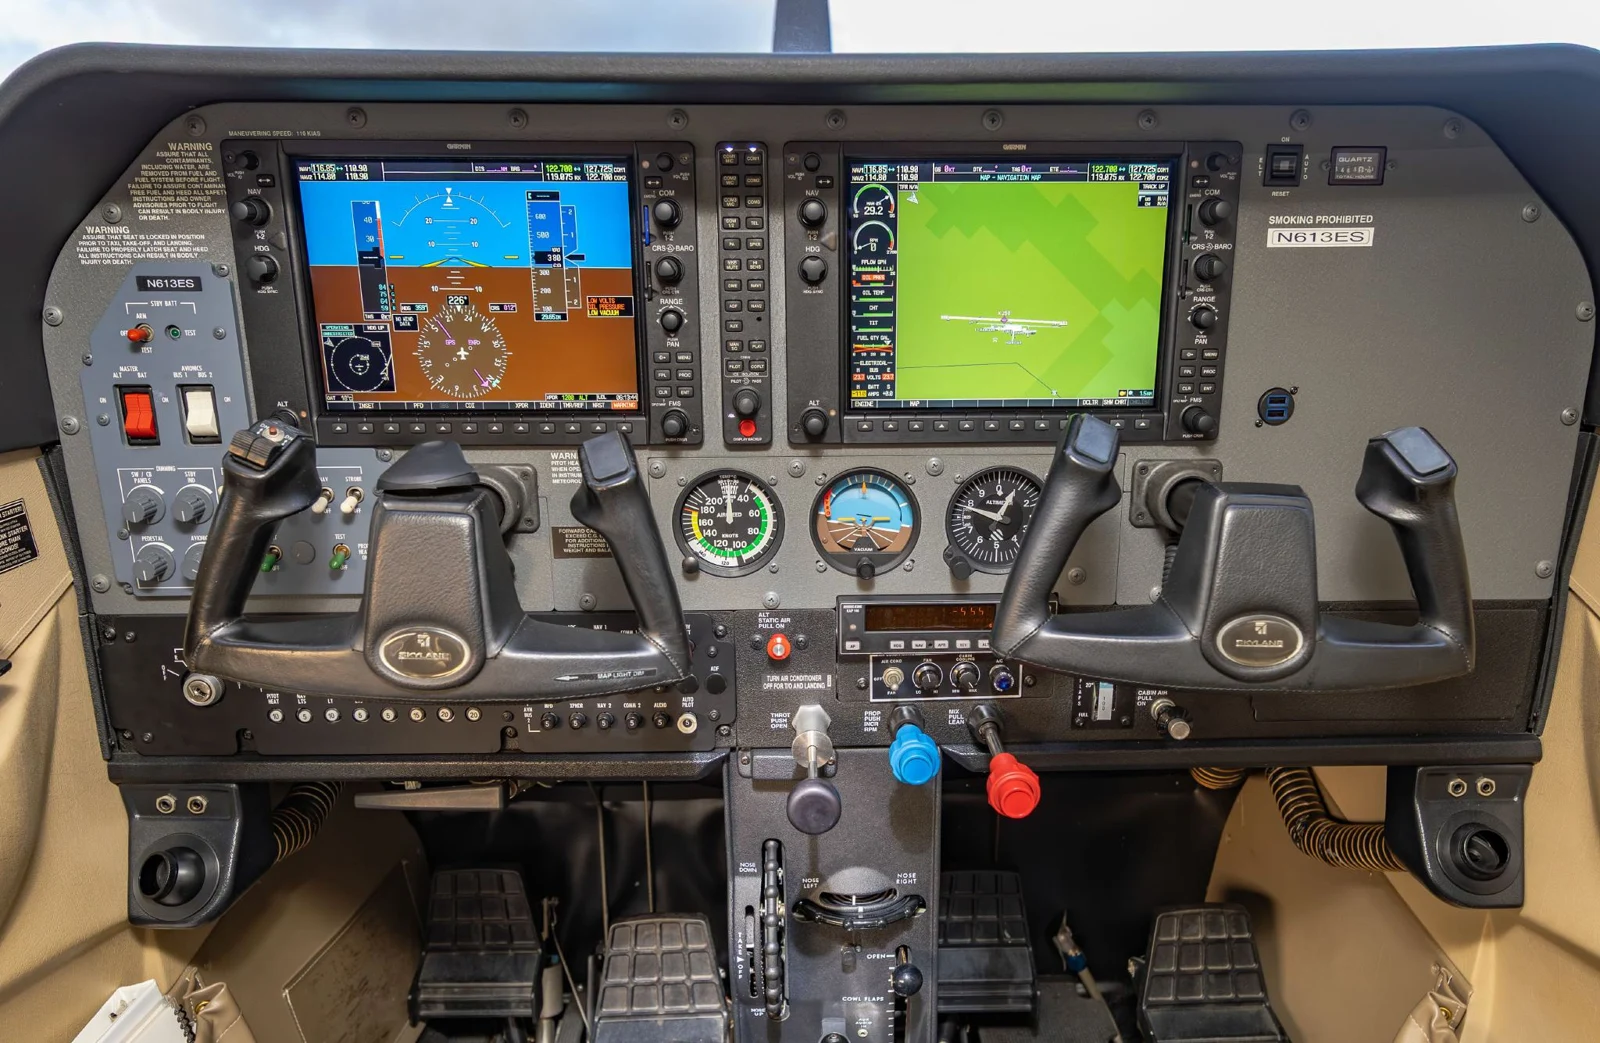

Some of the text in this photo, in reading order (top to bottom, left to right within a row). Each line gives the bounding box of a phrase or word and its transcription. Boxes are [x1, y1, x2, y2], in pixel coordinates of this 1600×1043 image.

[344, 164, 368, 172] 110.90
[864, 206, 883, 215] 29.2
[1269, 215, 1373, 224] SMOKING PROHIBITED
[86, 226, 129, 234] WARNING
[1277, 232, 1364, 242] N613ES
[147, 279, 194, 288] N613ES
[706, 497, 723, 505] 200
[701, 506, 715, 514] 180
[8, 525, 28, 537] STARTER
[703, 529, 717, 537] 140
[733, 540, 747, 548] 100
[763, 682, 773, 690] OFF
[774, 682, 783, 690] FOR
[793, 682, 803, 690] AND
[804, 682, 826, 690] LANDING
[441, 710, 449, 718] 20
[469, 711, 478, 719] 20
